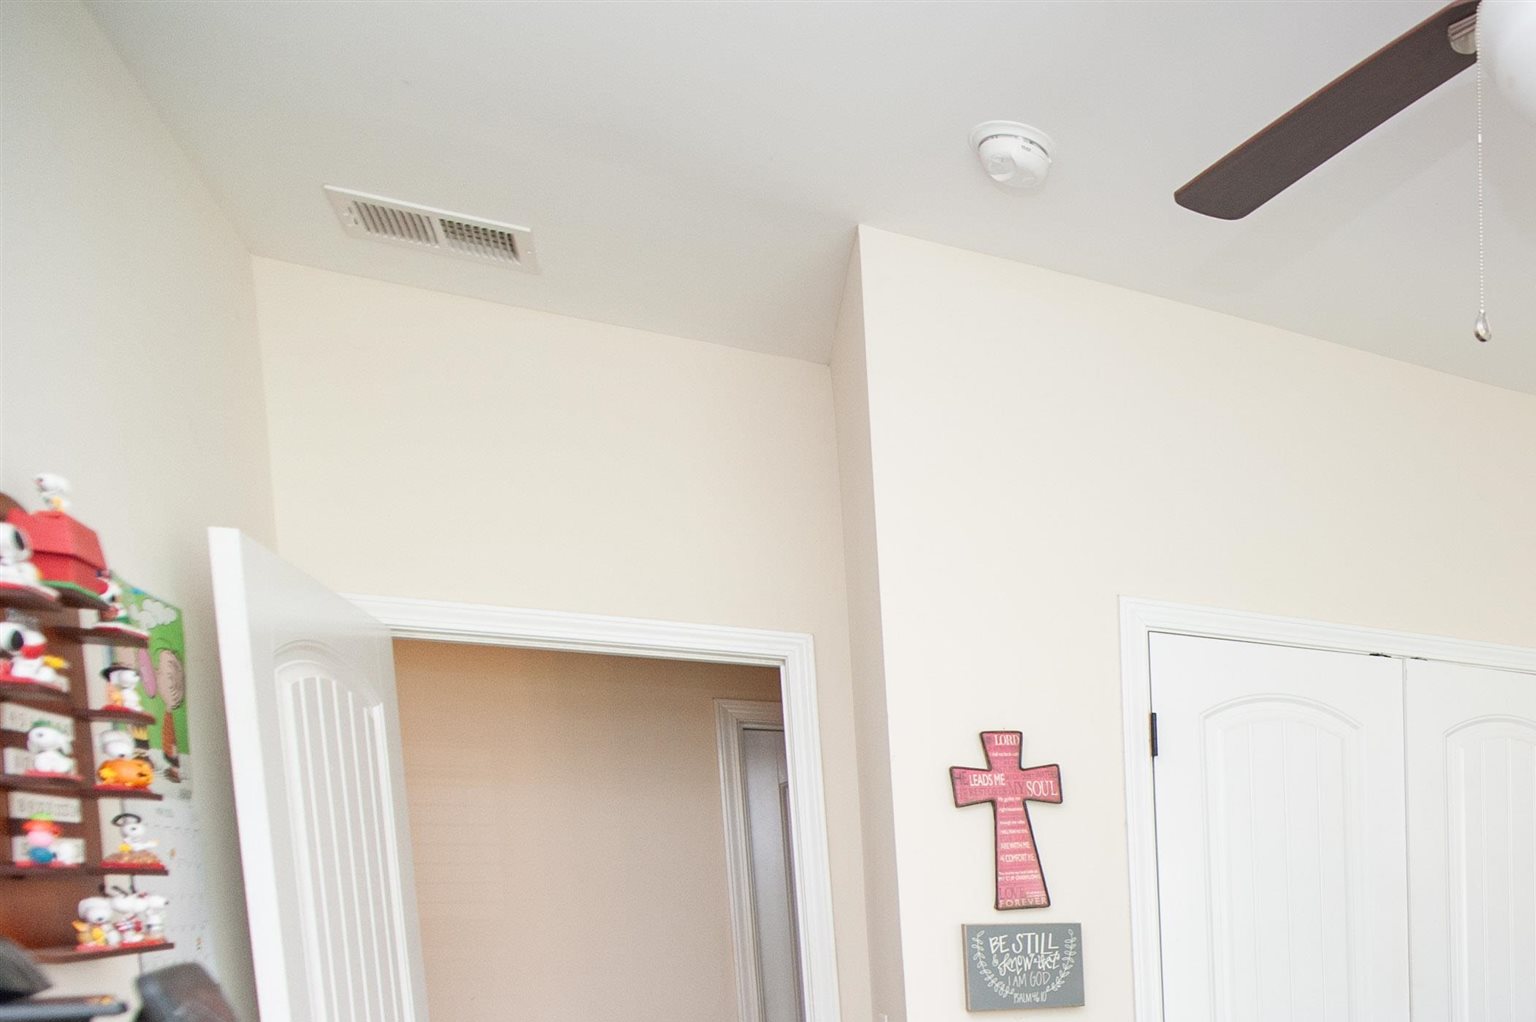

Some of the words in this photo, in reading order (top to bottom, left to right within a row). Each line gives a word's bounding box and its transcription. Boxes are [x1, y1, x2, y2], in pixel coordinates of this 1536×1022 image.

[994, 734, 1020, 746] LORD
[969, 774, 993, 787] LEADS
[994, 773, 1006, 786] ME
[1026, 780, 1057, 797] SOUL
[999, 897, 1048, 908] FOREVER
[989, 934, 1009, 954] BE
[1012, 932, 1060, 954] STILL
[1012, 973, 1027, 987] AM
[1029, 971, 1051, 987] GOD
